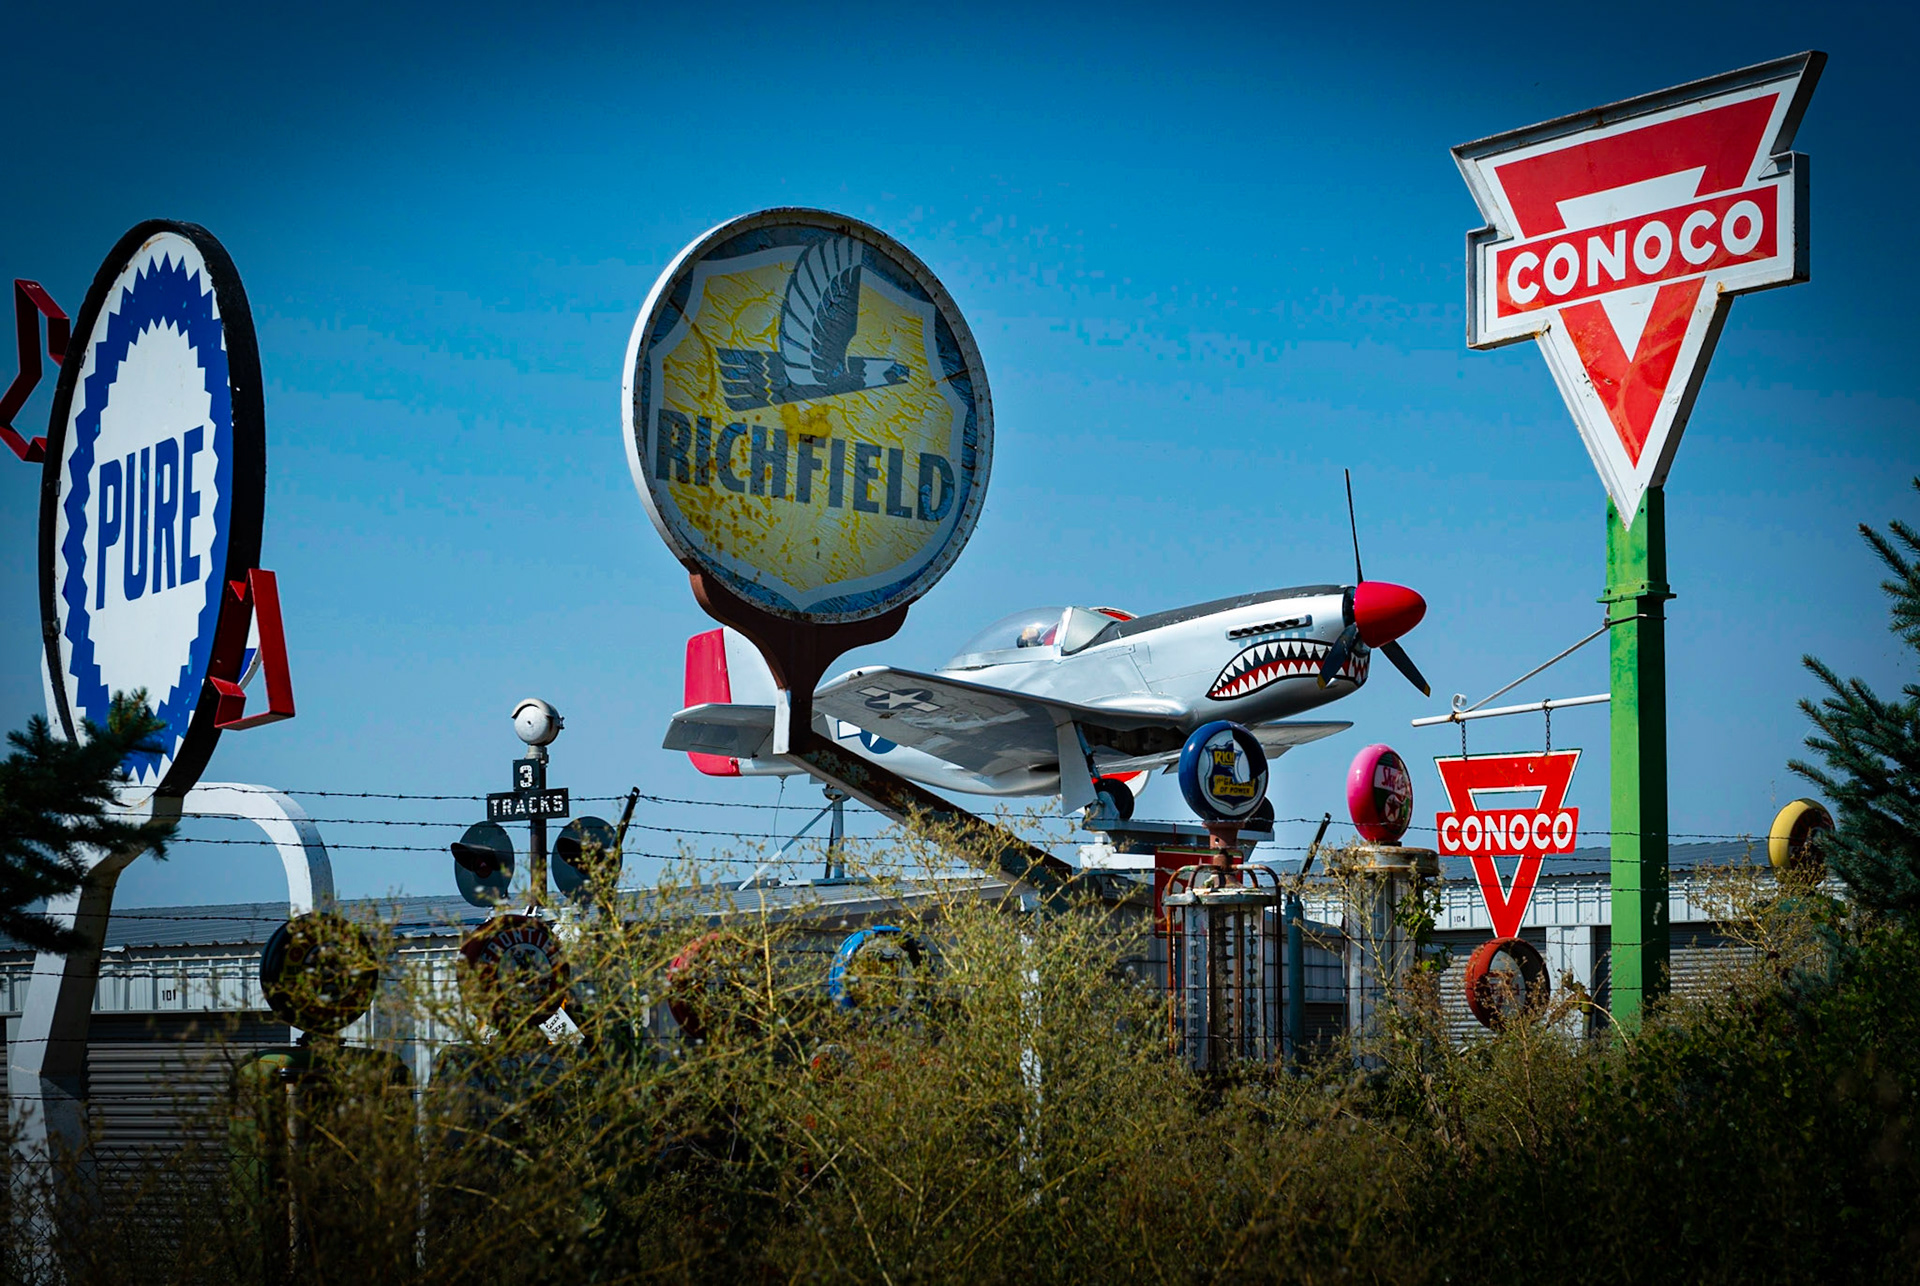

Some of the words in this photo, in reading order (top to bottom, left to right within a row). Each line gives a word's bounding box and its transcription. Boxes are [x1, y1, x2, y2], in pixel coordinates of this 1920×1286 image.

[1506, 199, 1764, 304] CONOCO
[655, 408, 956, 522] RICHFIELD
[95, 425, 204, 611] PURE
[519, 764, 533, 788] 3
[490, 794, 564, 817] TRACKS
[1441, 812, 1573, 851] CONOCO
[1453, 915, 1466, 923] 104
[162, 989, 176, 1001] 101
